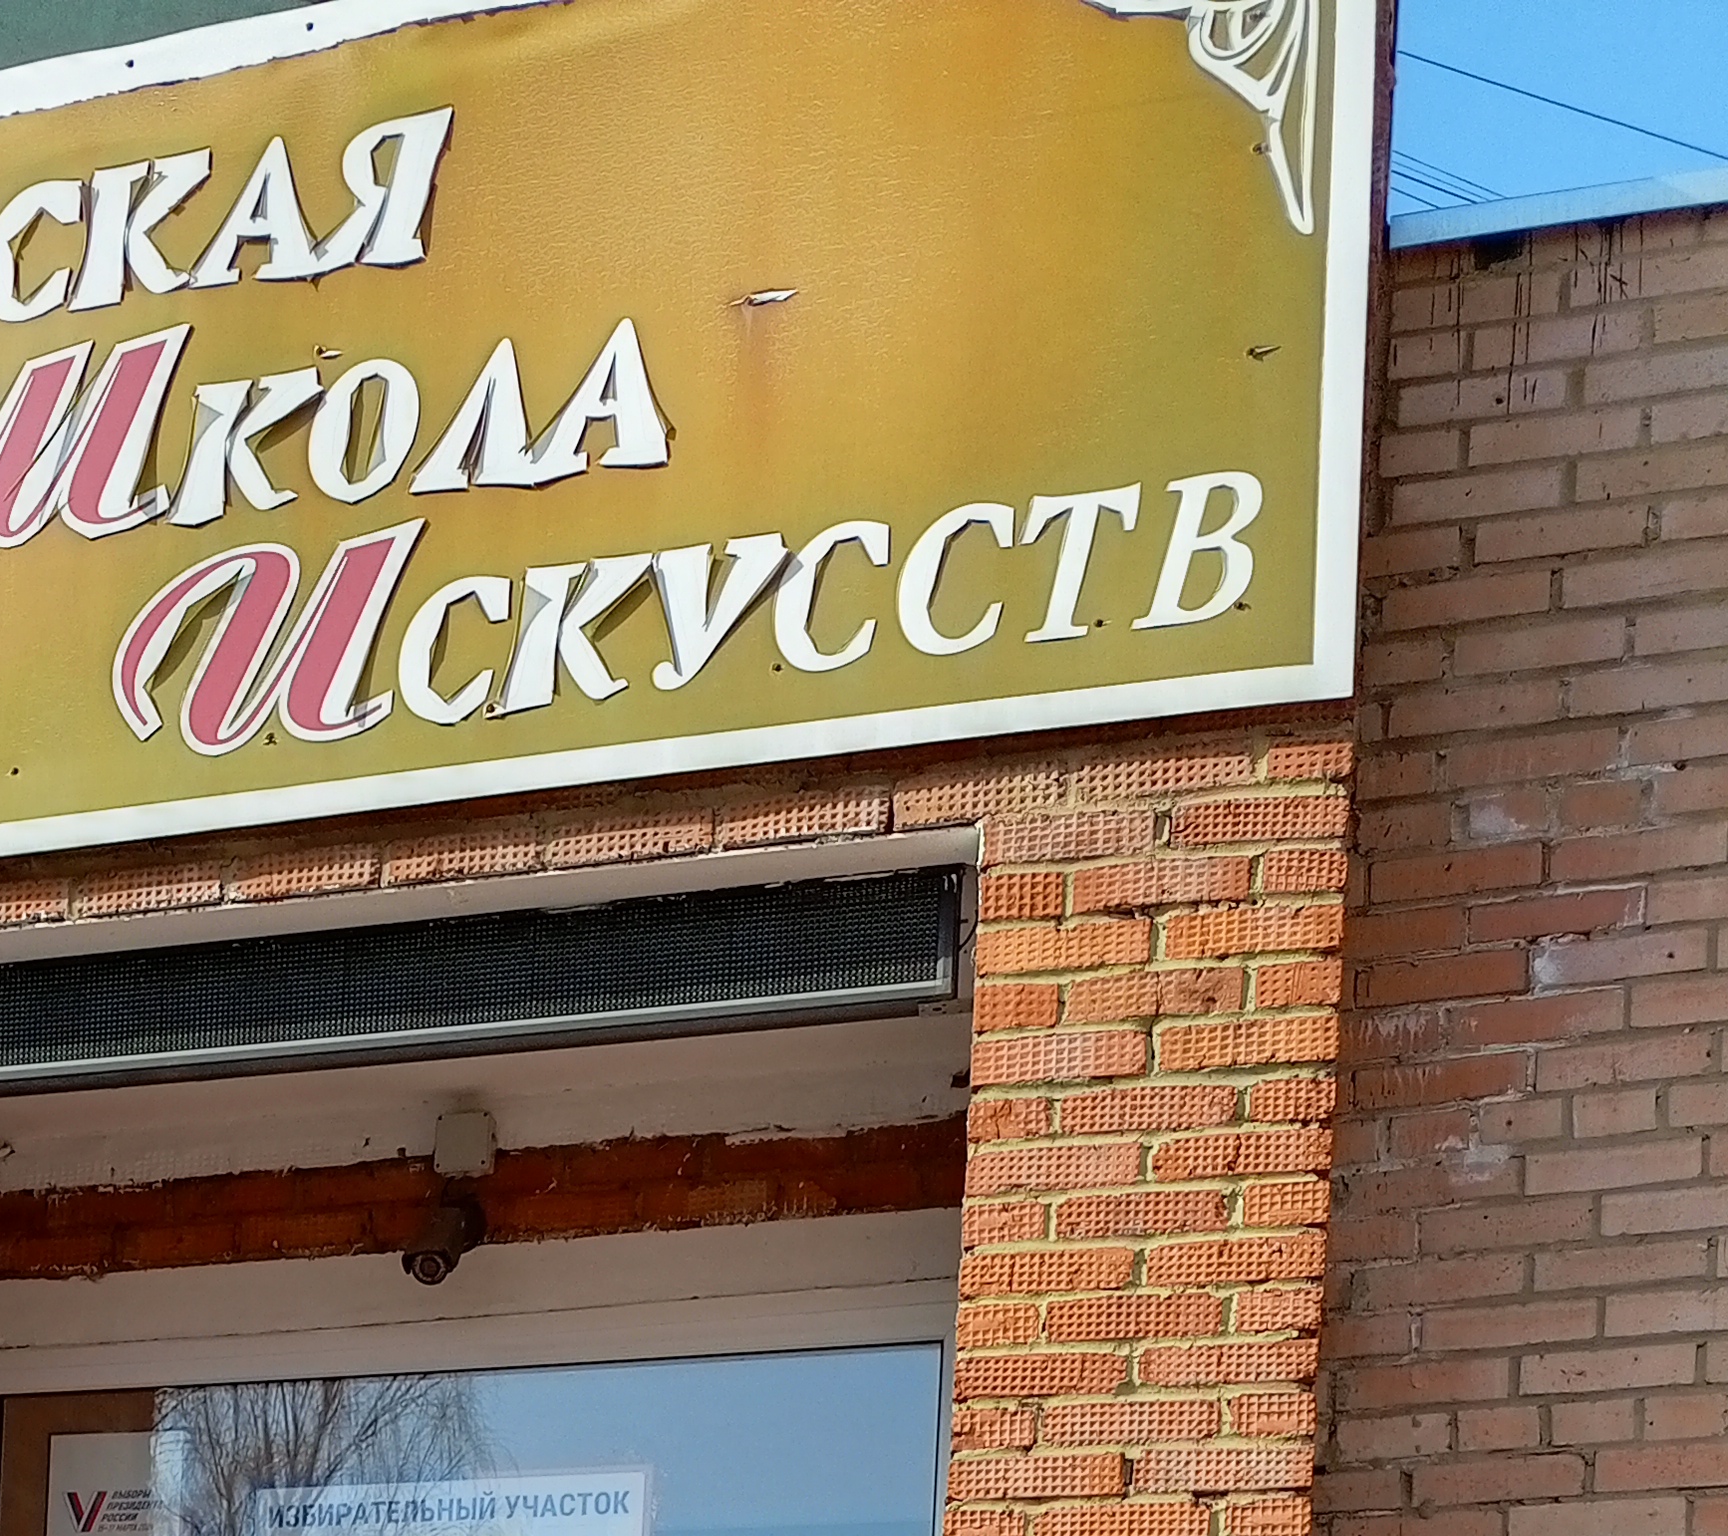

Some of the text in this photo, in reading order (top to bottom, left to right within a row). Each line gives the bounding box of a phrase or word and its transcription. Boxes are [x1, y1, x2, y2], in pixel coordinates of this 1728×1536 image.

[111, 1489, 152, 1500] ВЫБОРЫ
[267, 1490, 630, 1528] ИЗБИРАТЕЛЬНЫЙ УЧАСТОК
[100, 1512, 139, 1522] РОССИИ
